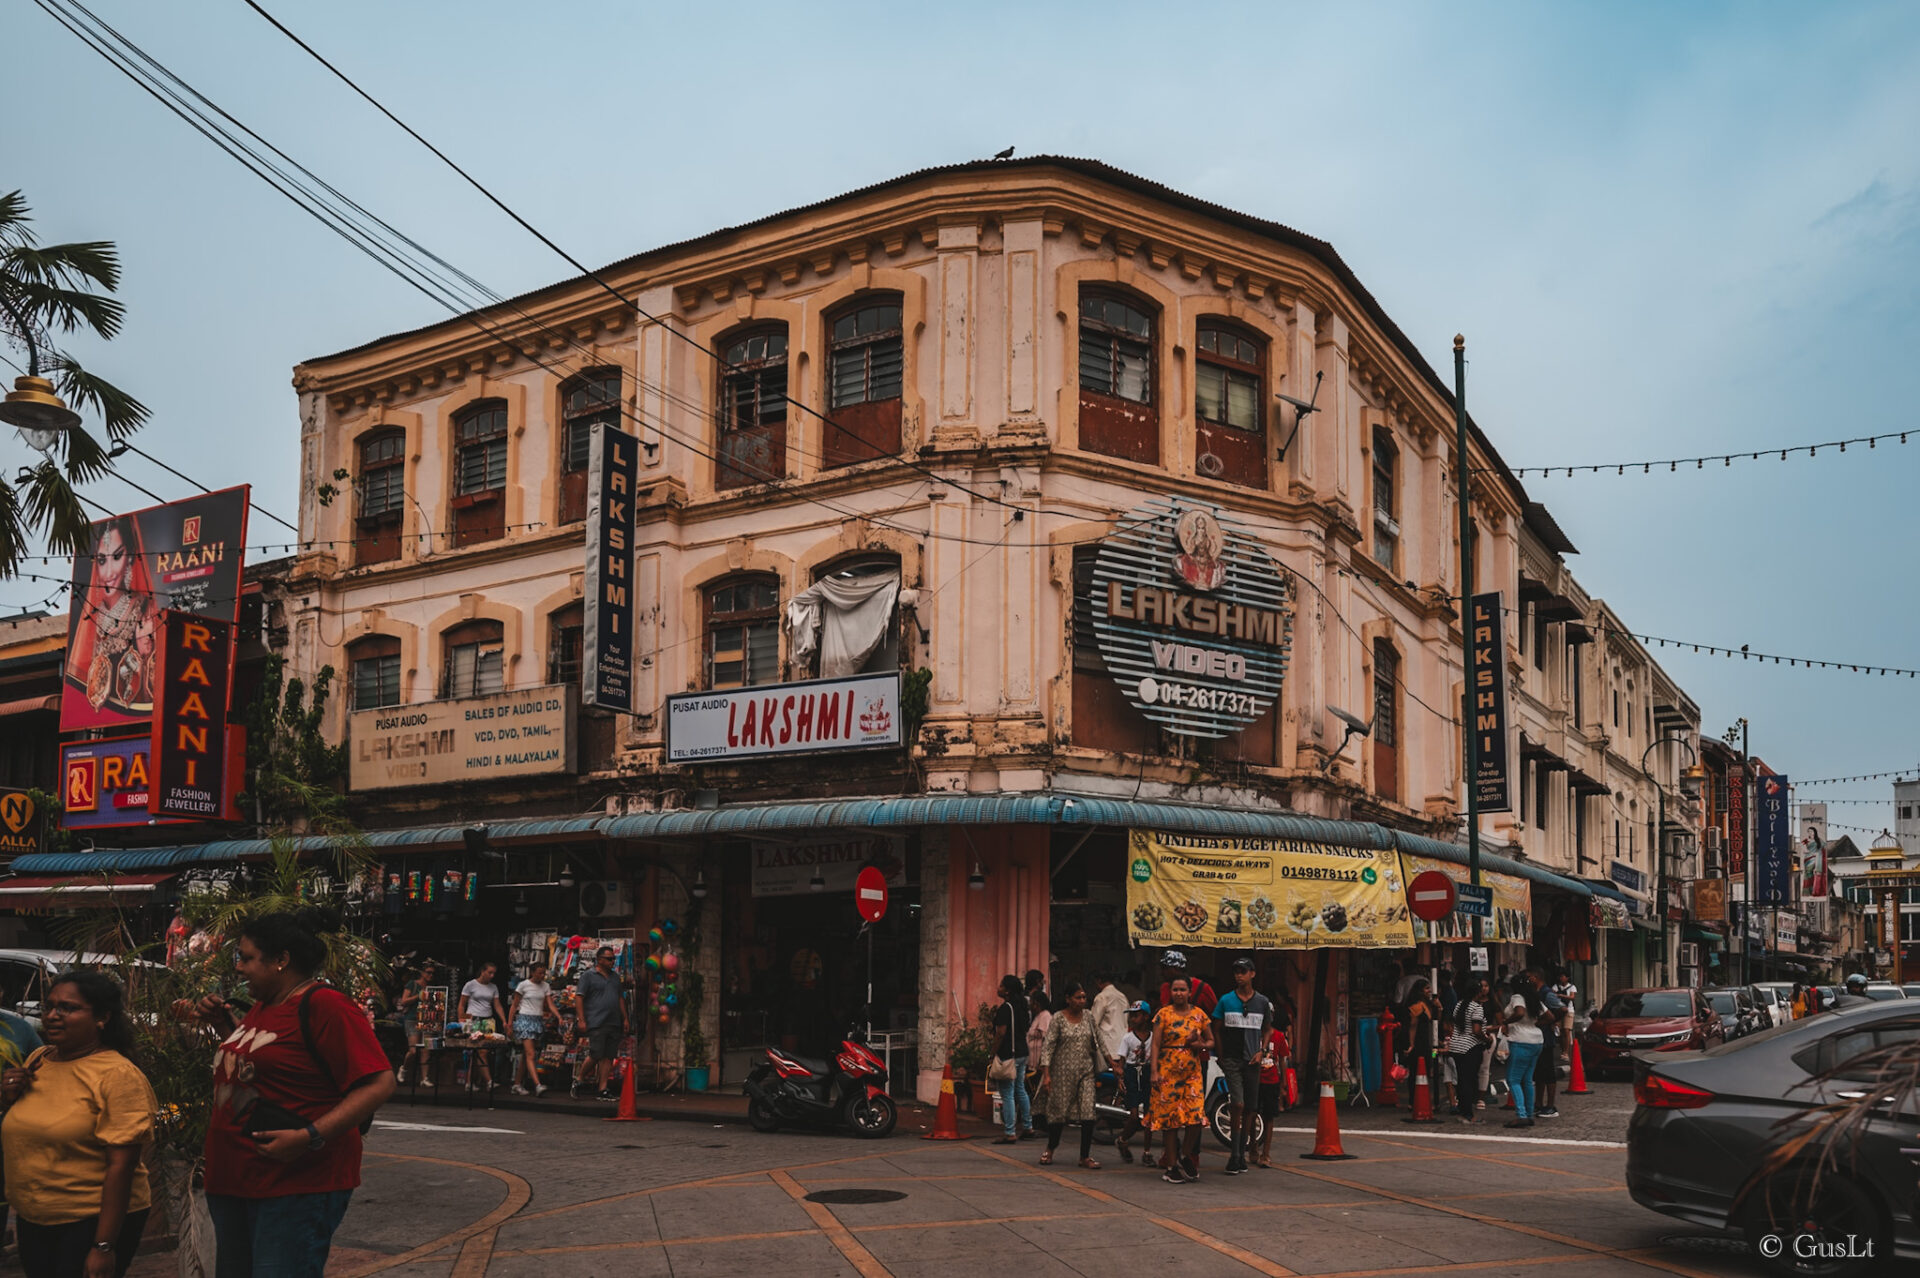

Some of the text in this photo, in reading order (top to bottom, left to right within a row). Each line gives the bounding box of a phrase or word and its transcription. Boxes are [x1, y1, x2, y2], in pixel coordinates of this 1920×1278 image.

[606, 442, 627, 635] LAKSHMI
[157, 541, 224, 573] RAANI
[1107, 581, 1284, 646] LAKSHMI
[1151, 639, 1246, 681] VIDEO
[1475, 605, 1497, 753] LAKSHMI
[177, 621, 213, 788] RAANI
[465, 699, 562, 722] SALES OF AUDIO CD,
[673, 699, 728, 713] PUSAT AUDIO
[1160, 682, 1256, 716] 04-2617371
[375, 713, 428, 731] PUSAT AUDIO
[726, 689, 854, 749] LAKSHMI
[474, 724, 552, 743] VCD, DVD, TAMIL,
[359, 728, 455, 763] LAKSHMI
[674, 746, 727, 757] TEL: 04-2617371
[466, 749, 560, 768] HINDI & MALAYALAM
[102, 752, 149, 790] RA
[386, 761, 428, 780] VIDEO
[164, 798, 217, 812] JEWELLERY
[171, 787, 212, 801] FASHION
[1729, 776, 1744, 873] KARAIKUDI
[756, 841, 865, 868] LAKSHMI
[1231, 838, 1323, 855] VEGETARIAN
[1325, 845, 1375, 859] SNACKS
[1160, 856, 1270, 869] HOT & DELICIOUS ALWAYS
[1281, 866, 1358, 881] 0149878112
[1192, 870, 1237, 880] GRAB & GO
